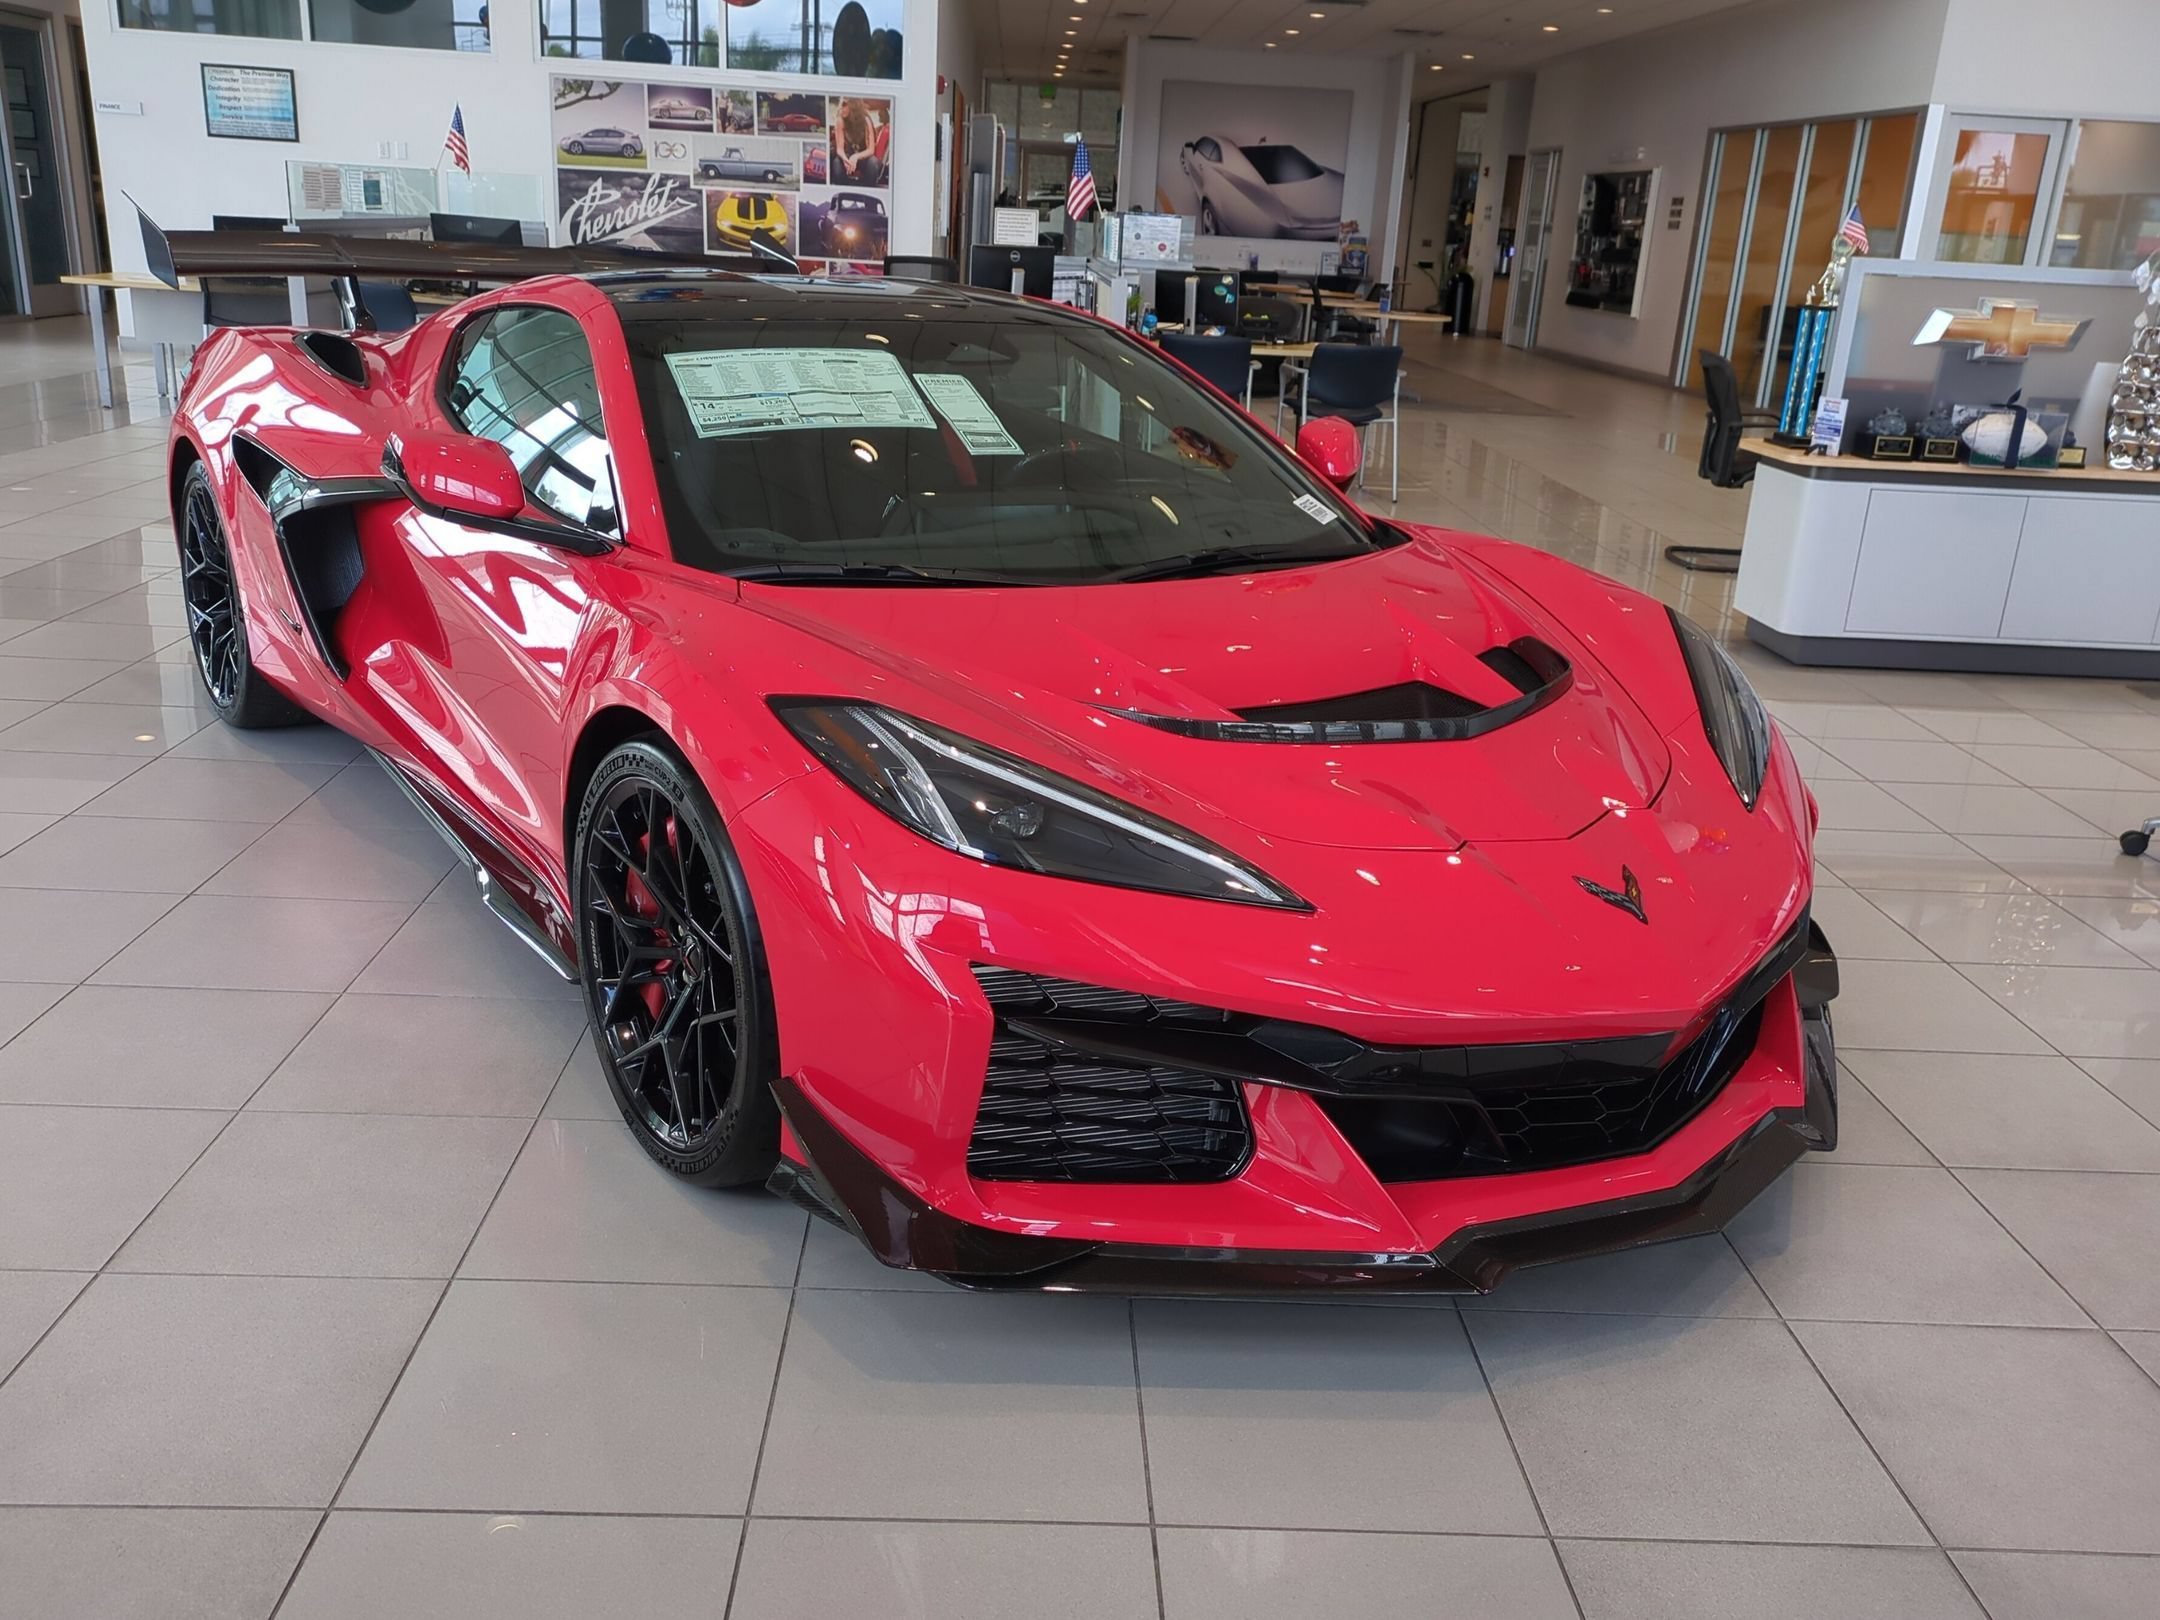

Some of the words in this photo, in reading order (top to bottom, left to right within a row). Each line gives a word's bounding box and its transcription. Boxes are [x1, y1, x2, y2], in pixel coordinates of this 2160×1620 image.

[209, 75, 240, 83] Character
[207, 84, 241, 92] Dedication
[215, 94, 241, 103] Integrity
[219, 103, 242, 111] Respect
[221, 113, 243, 121] Service
[560, 172, 698, 246] Chevrolet
[700, 402, 716, 410] 14
[591, 754, 626, 797] MICHELIN
[589, 919, 599, 969] FORGED
[679, 1148, 719, 1174] MICHELIN
